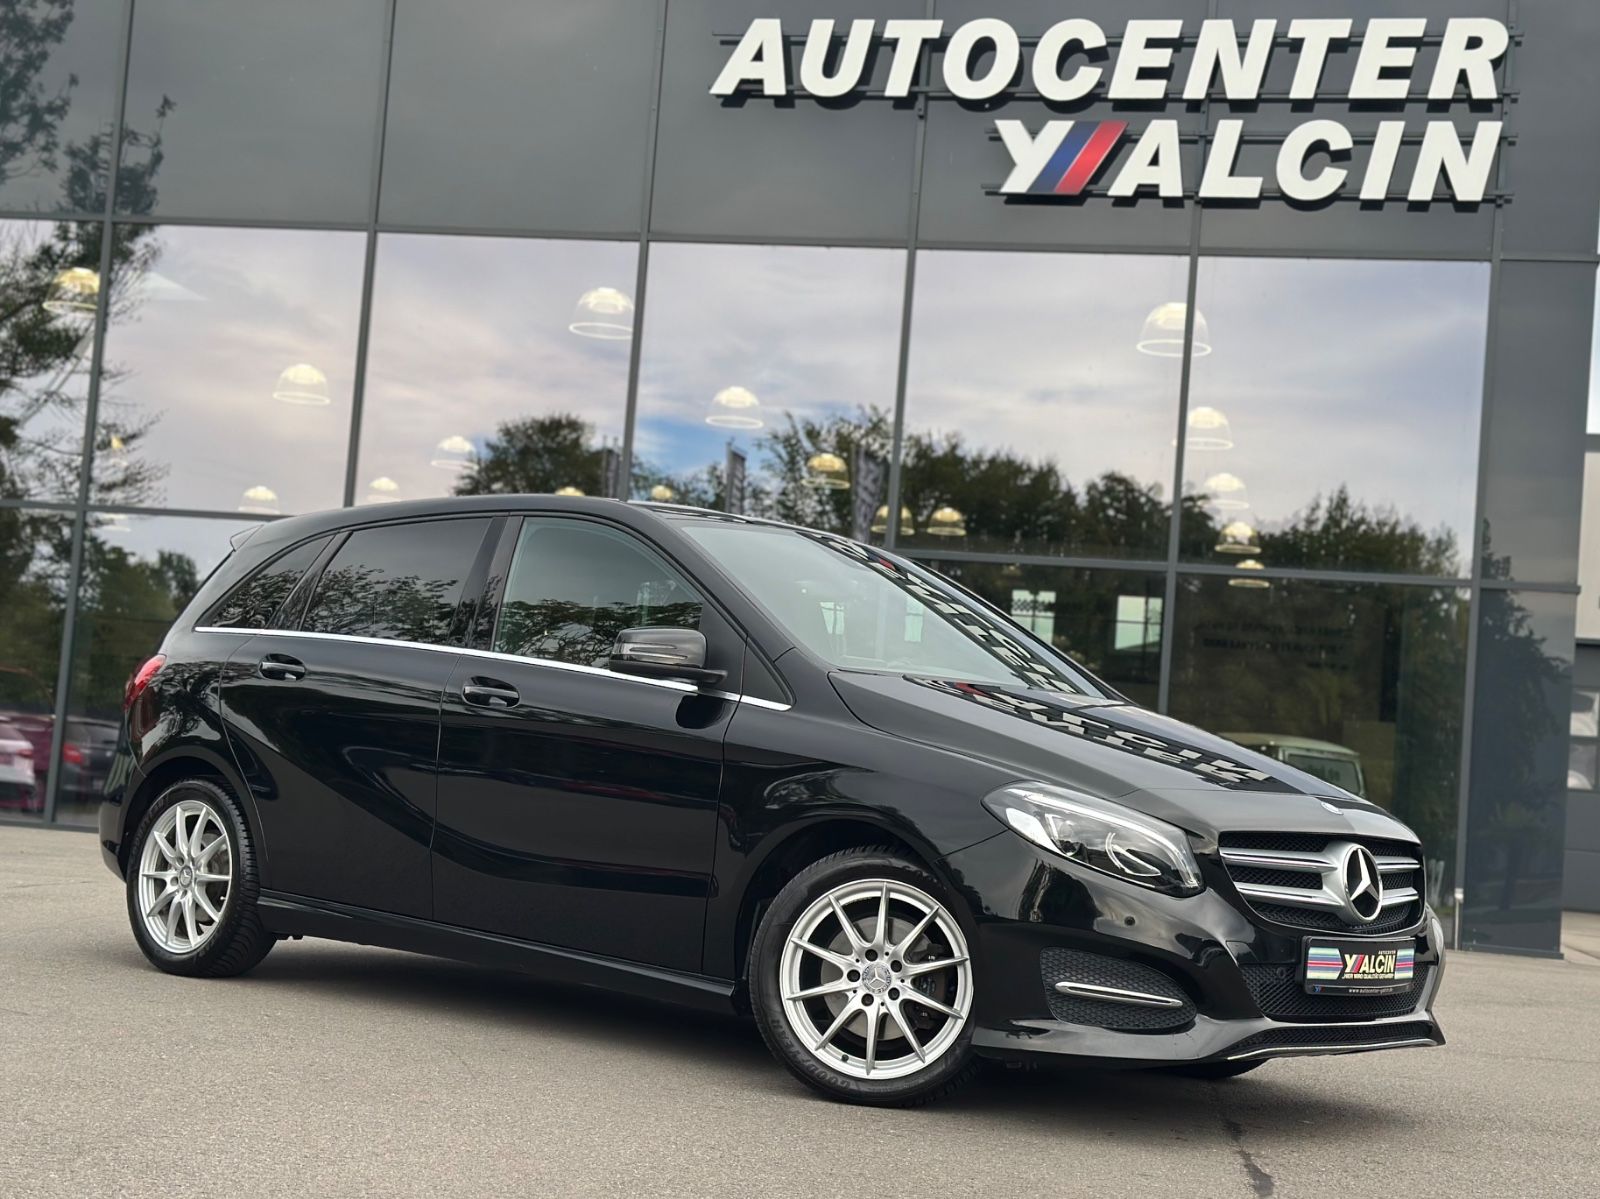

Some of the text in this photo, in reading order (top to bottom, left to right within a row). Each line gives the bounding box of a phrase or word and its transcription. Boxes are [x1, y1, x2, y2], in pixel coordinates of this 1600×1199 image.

[709, 18, 1509, 101] AUTOCENTER
[994, 119, 1503, 201] YALCIN
[1344, 954, 1396, 973] YALCIN
